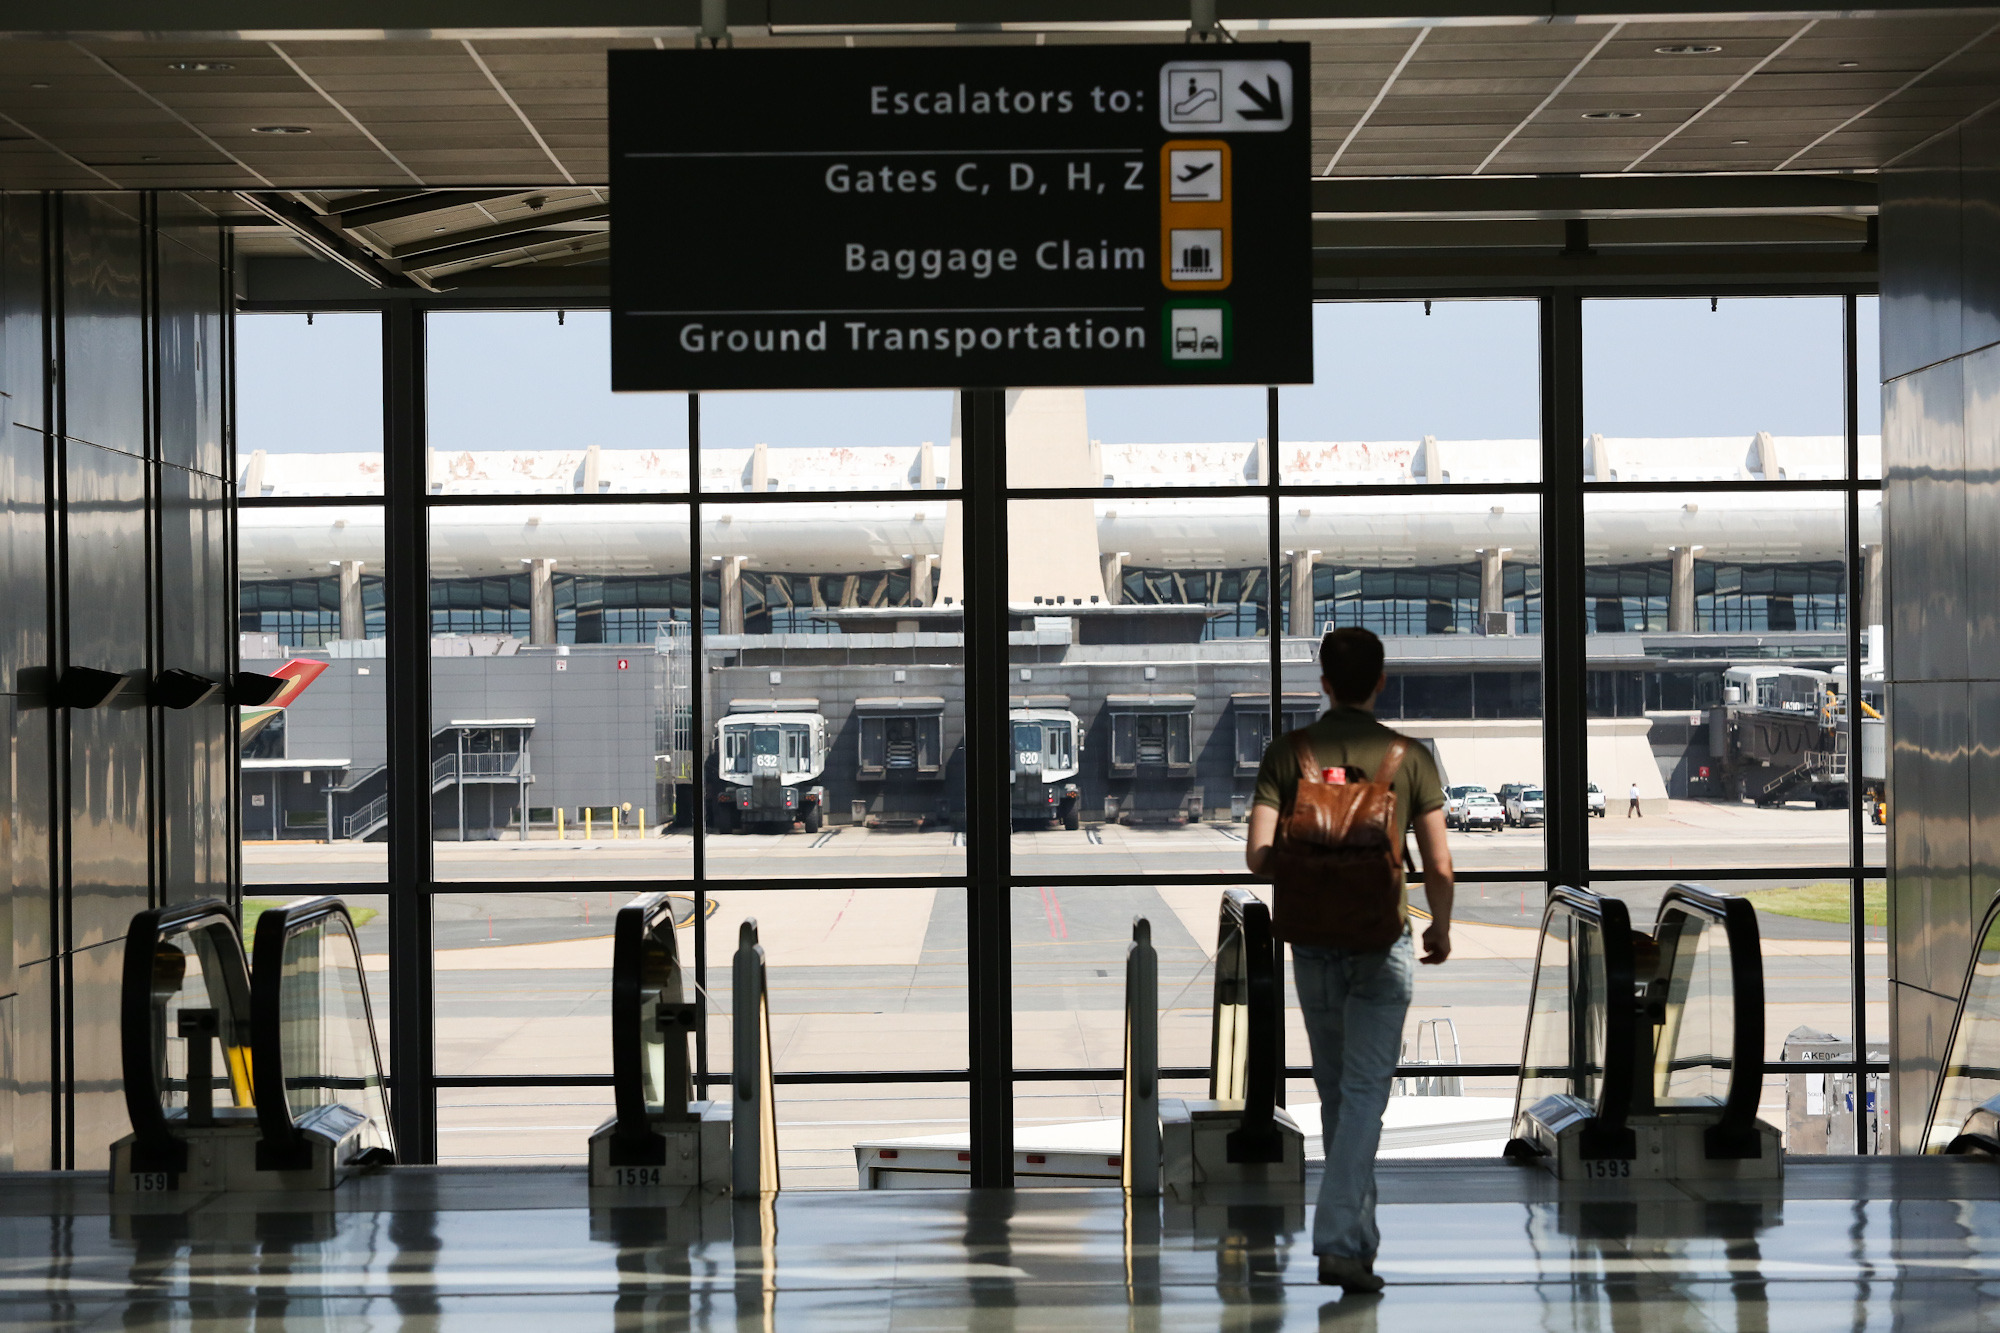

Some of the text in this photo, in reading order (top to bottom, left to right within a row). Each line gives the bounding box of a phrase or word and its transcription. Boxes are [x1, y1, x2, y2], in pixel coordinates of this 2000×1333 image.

[870, 84, 1144, 115] Escalators to:
[824, 161, 1145, 196] Gates C, D, H, Z
[845, 239, 1146, 280] Baggage Claim
[679, 318, 1146, 357] Ground Transportation
[756, 755, 778, 767] 632
[1019, 752, 1039, 765] 620
[616, 1168, 660, 1187] 1594
[1585, 1160, 1630, 1179] 1593
